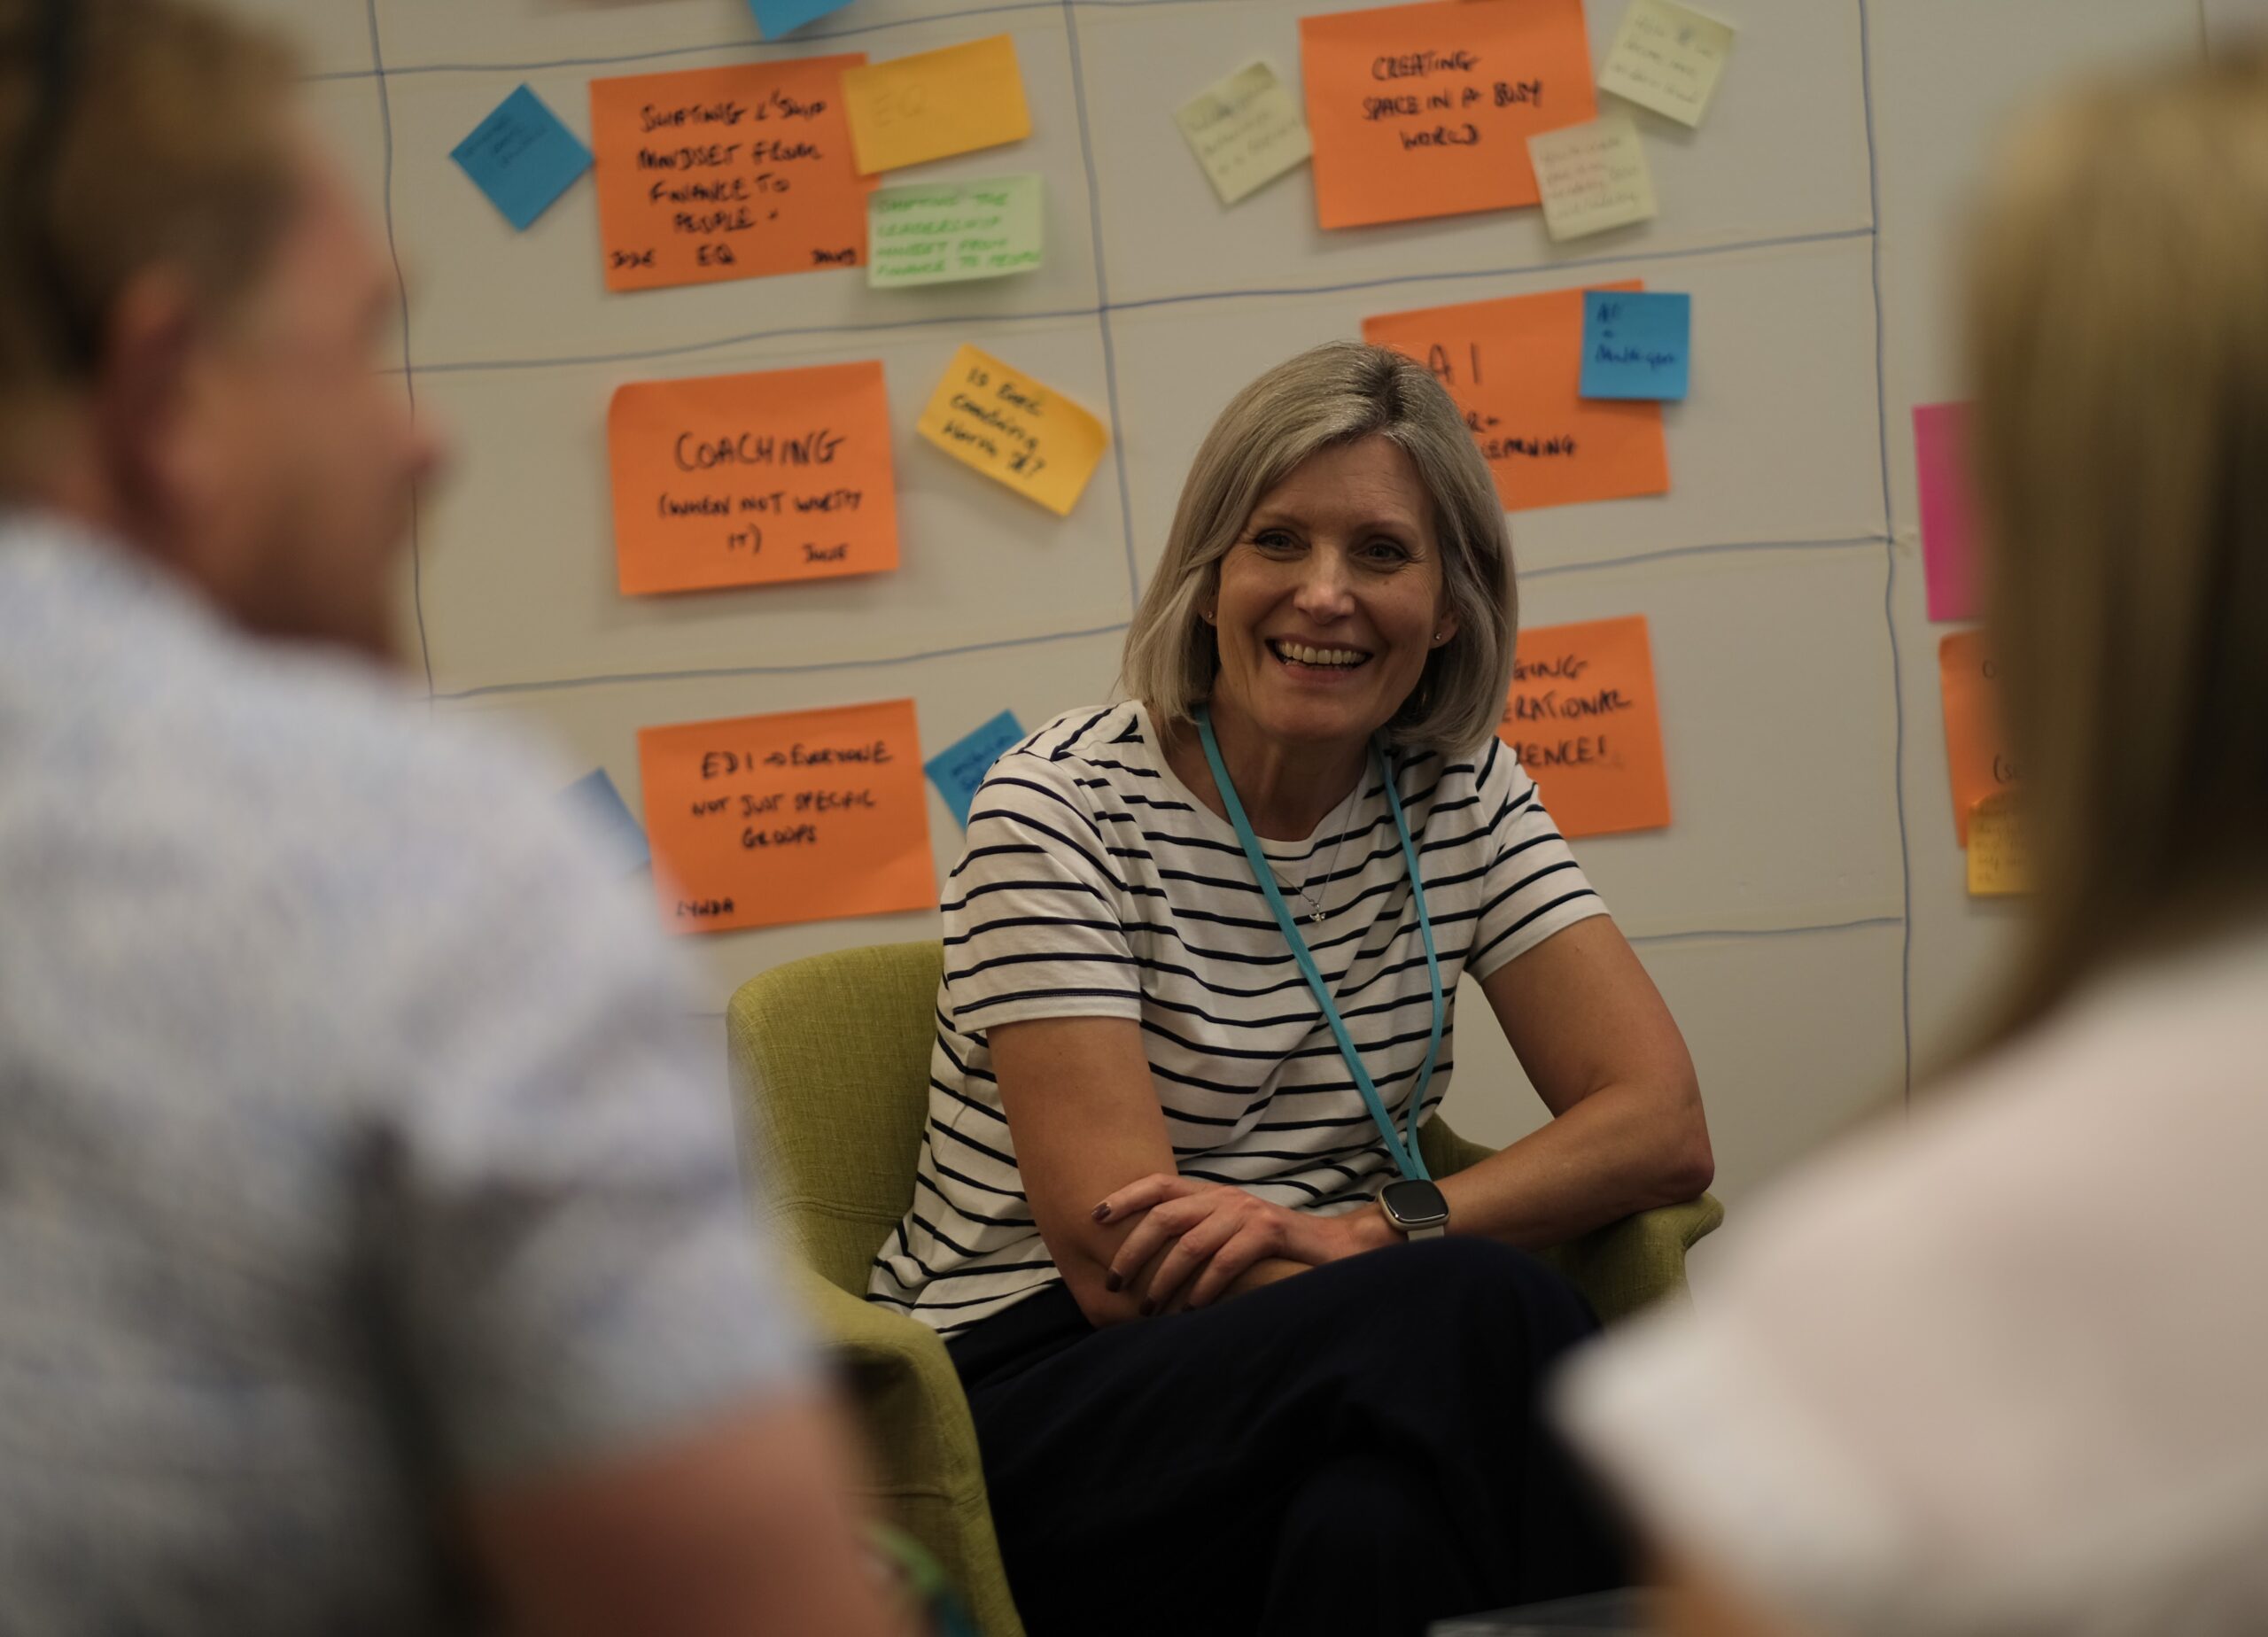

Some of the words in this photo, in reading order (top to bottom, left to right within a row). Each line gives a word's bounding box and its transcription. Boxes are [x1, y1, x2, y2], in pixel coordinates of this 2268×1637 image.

[1372, 50, 1480, 81] CREATING
[1362, 94, 1420, 120] SPACE
[1427, 87, 1453, 110] IN
[1493, 79, 1542, 107] BUSY
[641, 101, 747, 133] SHIFTING
[1400, 124, 1480, 151] WORLD
[752, 142, 822, 166] FROM
[650, 178, 750, 206] FINANCE
[755, 173, 790, 194] TO
[697, 244, 736, 266] EQ
[1427, 343, 1483, 385] AI
[674, 430, 846, 472] COACHING
[1511, 654, 1588, 681] GING
[1501, 689, 1633, 723] ERATIONAL
[691, 796, 729, 818] NOT
[742, 793, 786, 818] JUST
[795, 788, 876, 811] SPECIFIC
[742, 824, 818, 850] GROUPS
